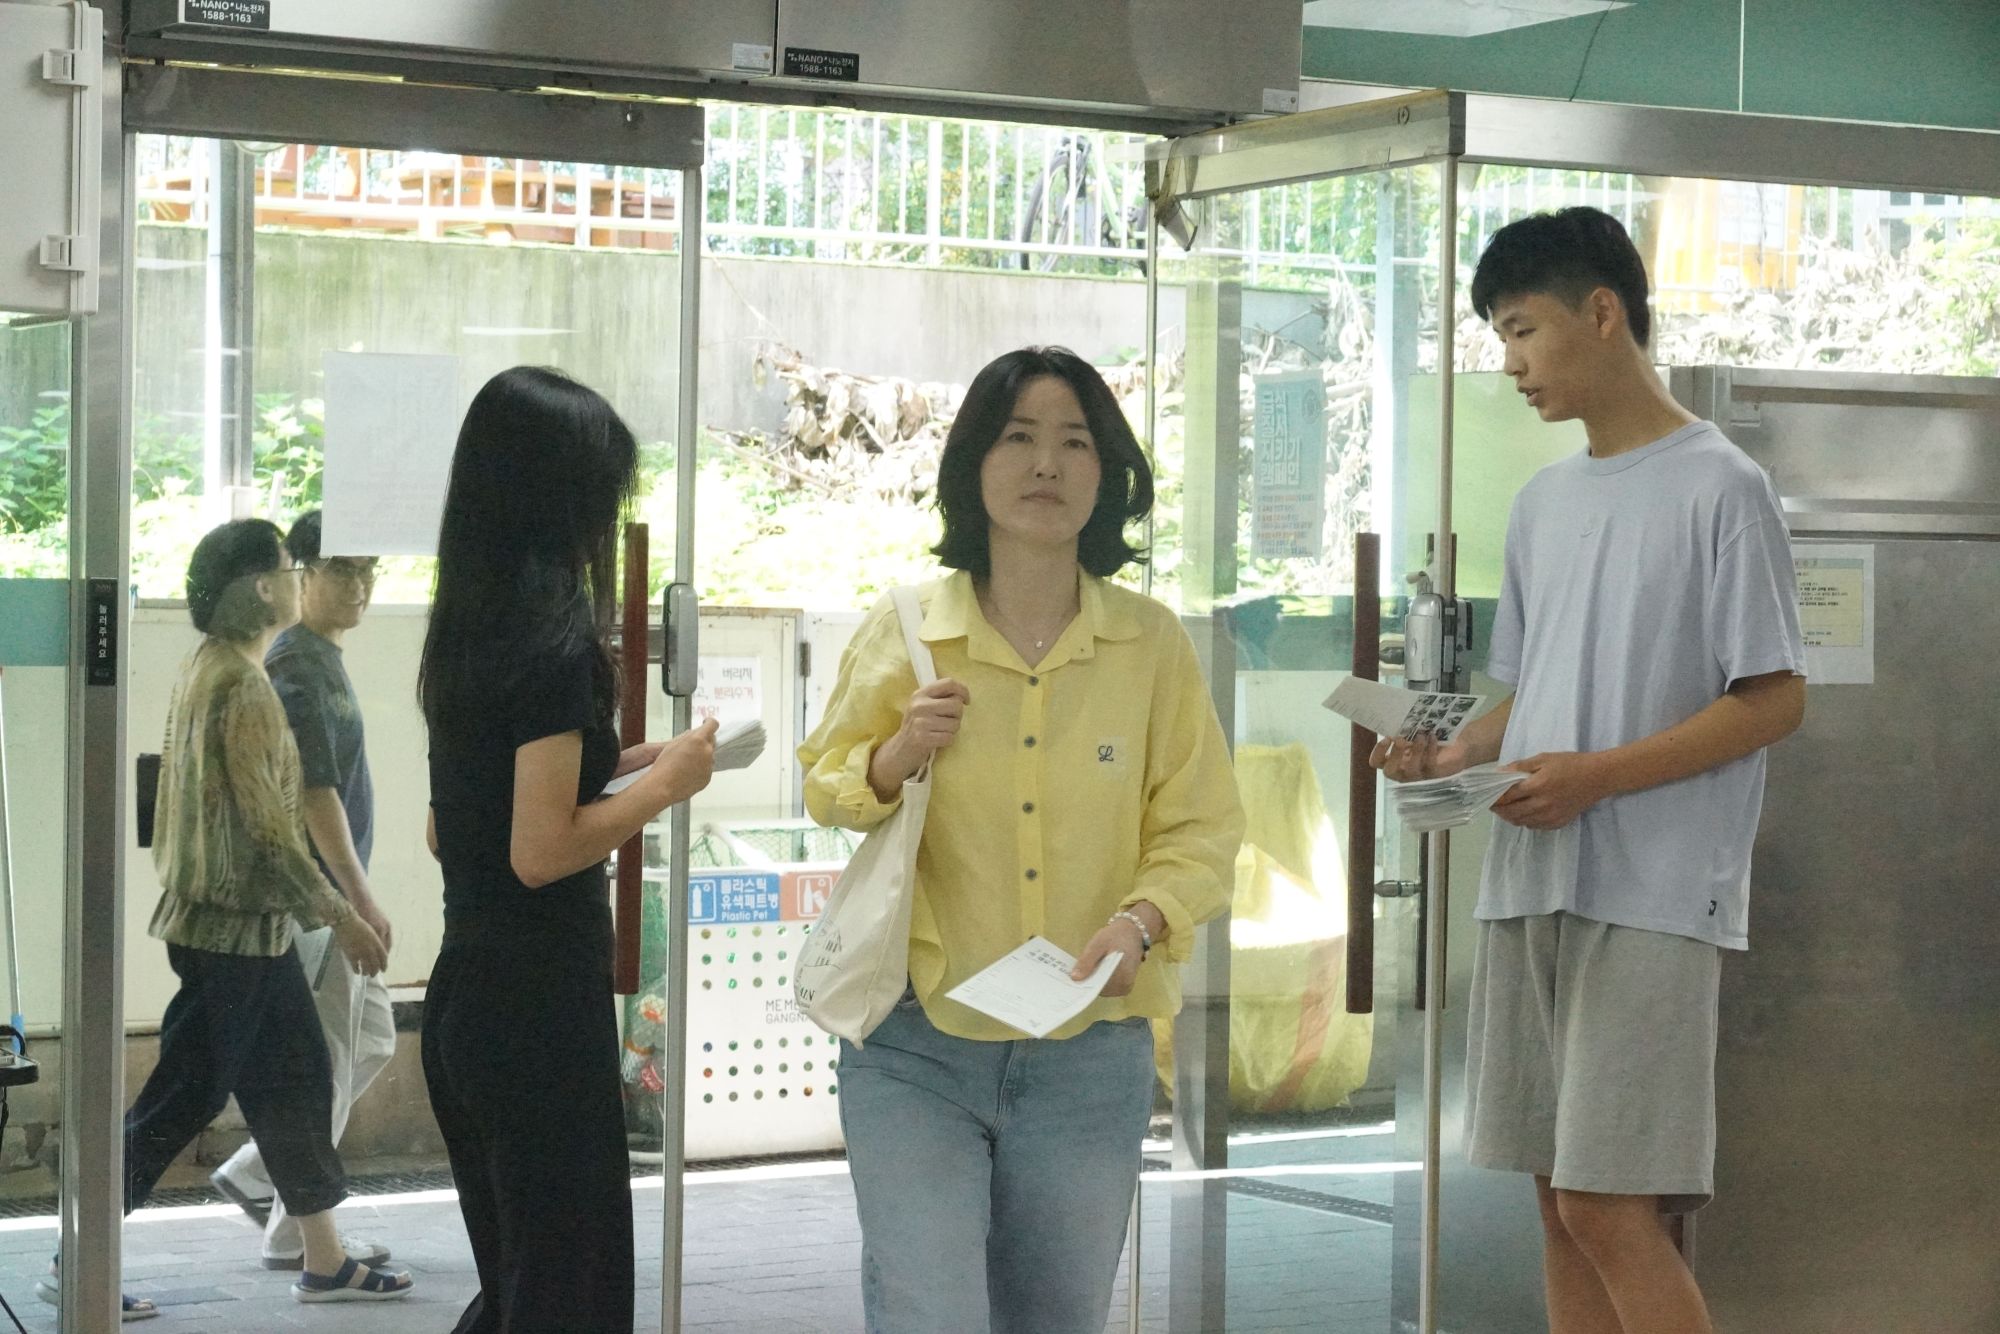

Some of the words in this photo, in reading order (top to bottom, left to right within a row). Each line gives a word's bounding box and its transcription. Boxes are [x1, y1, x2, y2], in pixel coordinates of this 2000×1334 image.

[200, 0, 229, 10] NANO
[202, 10, 252, 23] 1588-1163
[798, 53, 823, 64] NANO
[799, 64, 842, 76] 1588-1163
[99, 604, 107, 658] 눌러주세요
[721, 909, 751, 922] Plastic
[753, 909, 768, 921] Pet
